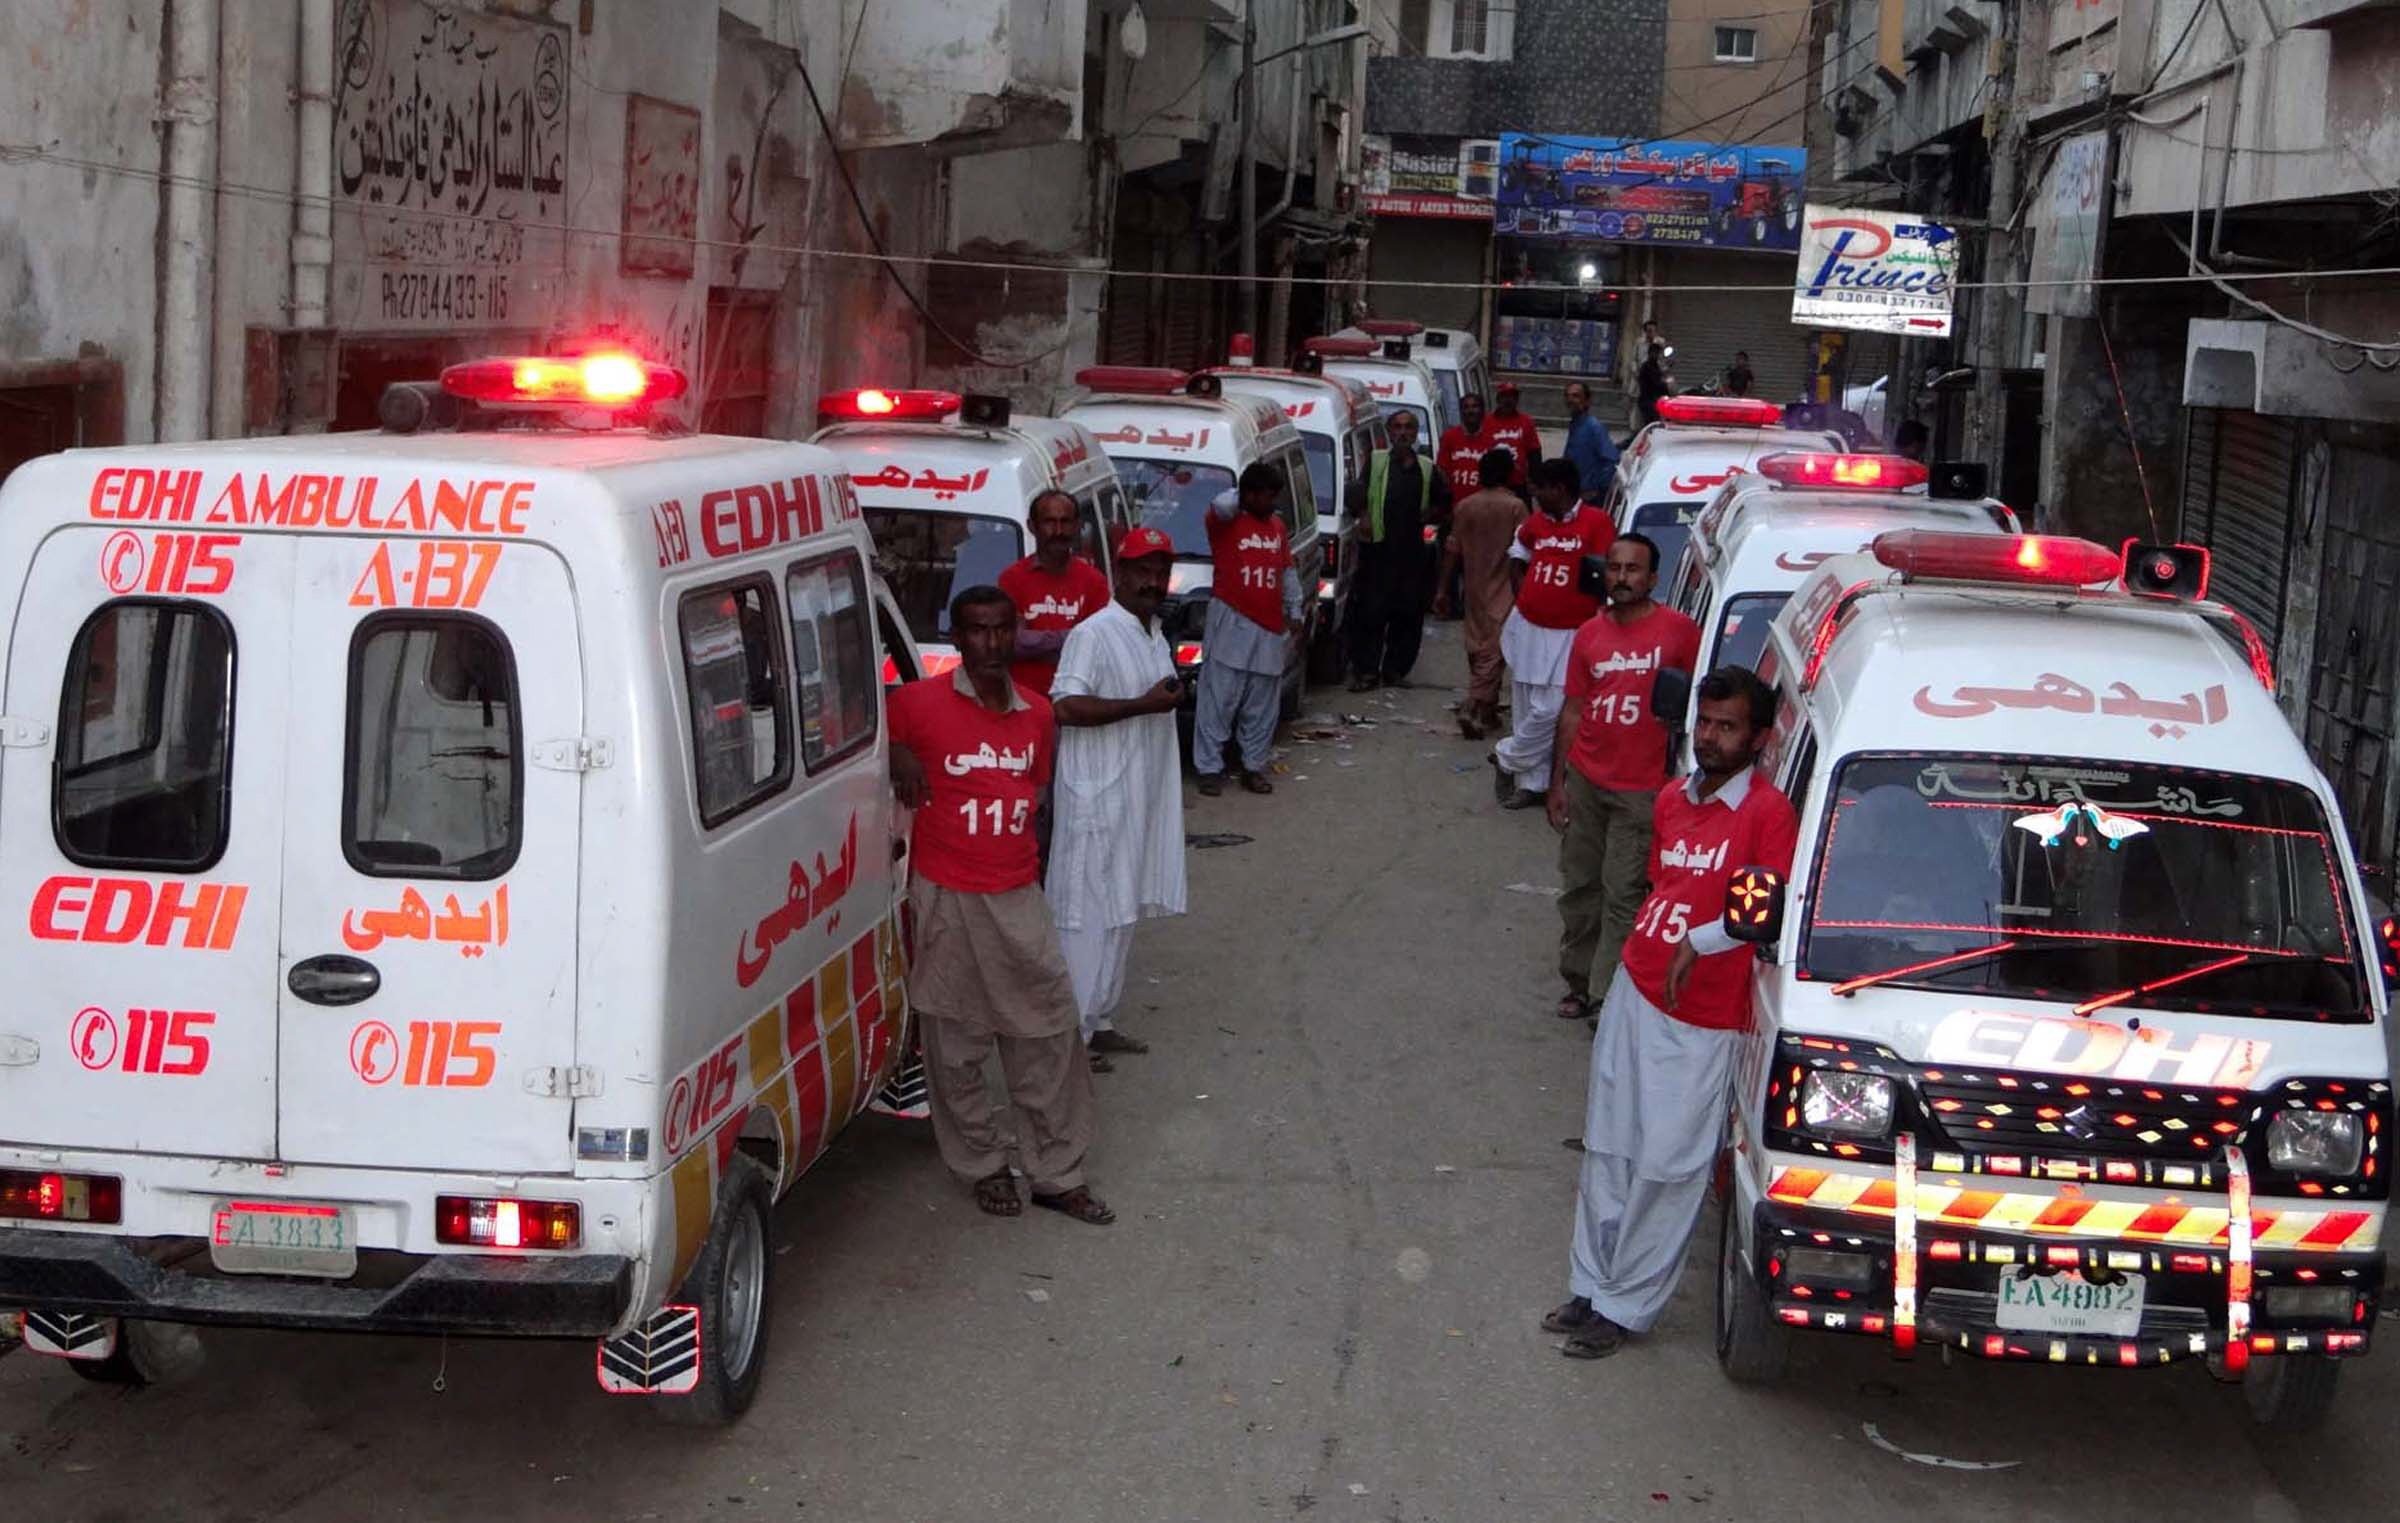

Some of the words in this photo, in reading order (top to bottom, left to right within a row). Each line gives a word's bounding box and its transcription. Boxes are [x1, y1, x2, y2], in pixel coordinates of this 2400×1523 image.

[1808, 218, 1949, 297] Prince
[89, 468, 203, 521] EDHI
[206, 472, 536, 534] AMBULANCE
[852, 465, 990, 501] ایدھ
[1452, 469, 1481, 487] 115
[701, 474, 823, 558] EDHI
[145, 535, 243, 594] 115
[1240, 565, 1277, 590] 115
[1534, 561, 1571, 587] 115
[1591, 693, 1641, 726] 115
[1913, 672, 2231, 741] ایدھی
[943, 742, 1035, 777] ایدھی
[959, 798, 1030, 836] 115
[29, 875, 250, 951] EDHI
[341, 883, 511, 959] ایدھی
[736, 807, 857, 989] ایدھی
[121, 1008, 217, 1077] 115
[402, 1020, 504, 1088] 115
[1925, 1010, 2272, 1091] EDHI
[688, 1033, 745, 1137] 115
[214, 1211, 255, 1246] EA
